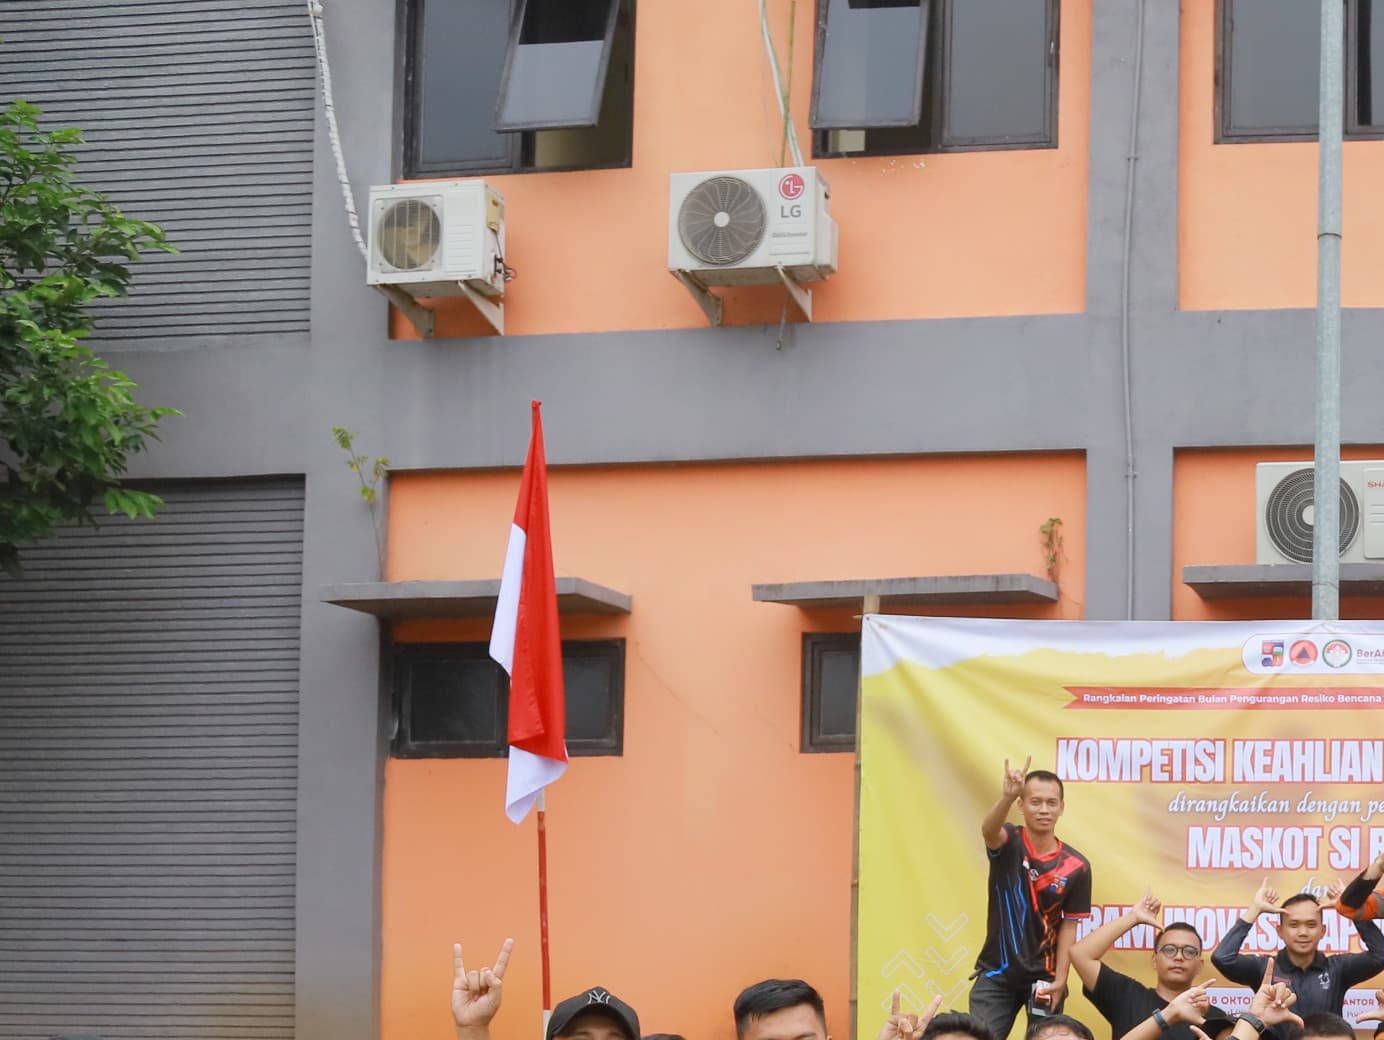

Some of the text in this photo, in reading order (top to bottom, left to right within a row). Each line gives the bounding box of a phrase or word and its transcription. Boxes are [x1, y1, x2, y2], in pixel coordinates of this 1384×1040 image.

[781, 205, 802, 218] LG
[1083, 693, 1137, 704] Rangkaian
[1139, 693, 1196, 704] Peringatan
[1198, 694, 1227, 704] Bulan
[1229, 694, 1299, 705] Pengurangan
[1301, 693, 1336, 703] Resiko
[1338, 694, 1382, 703] Bencana
[1057, 738, 1226, 783] KOMPETISI
[1232, 738, 1384, 784] KEAHLIAN
[1168, 791, 1290, 821] dirangkaikan
[1297, 791, 1361, 823] dengan
[1187, 825, 1324, 870] MASKOT
[1328, 825, 1363, 870] SI
